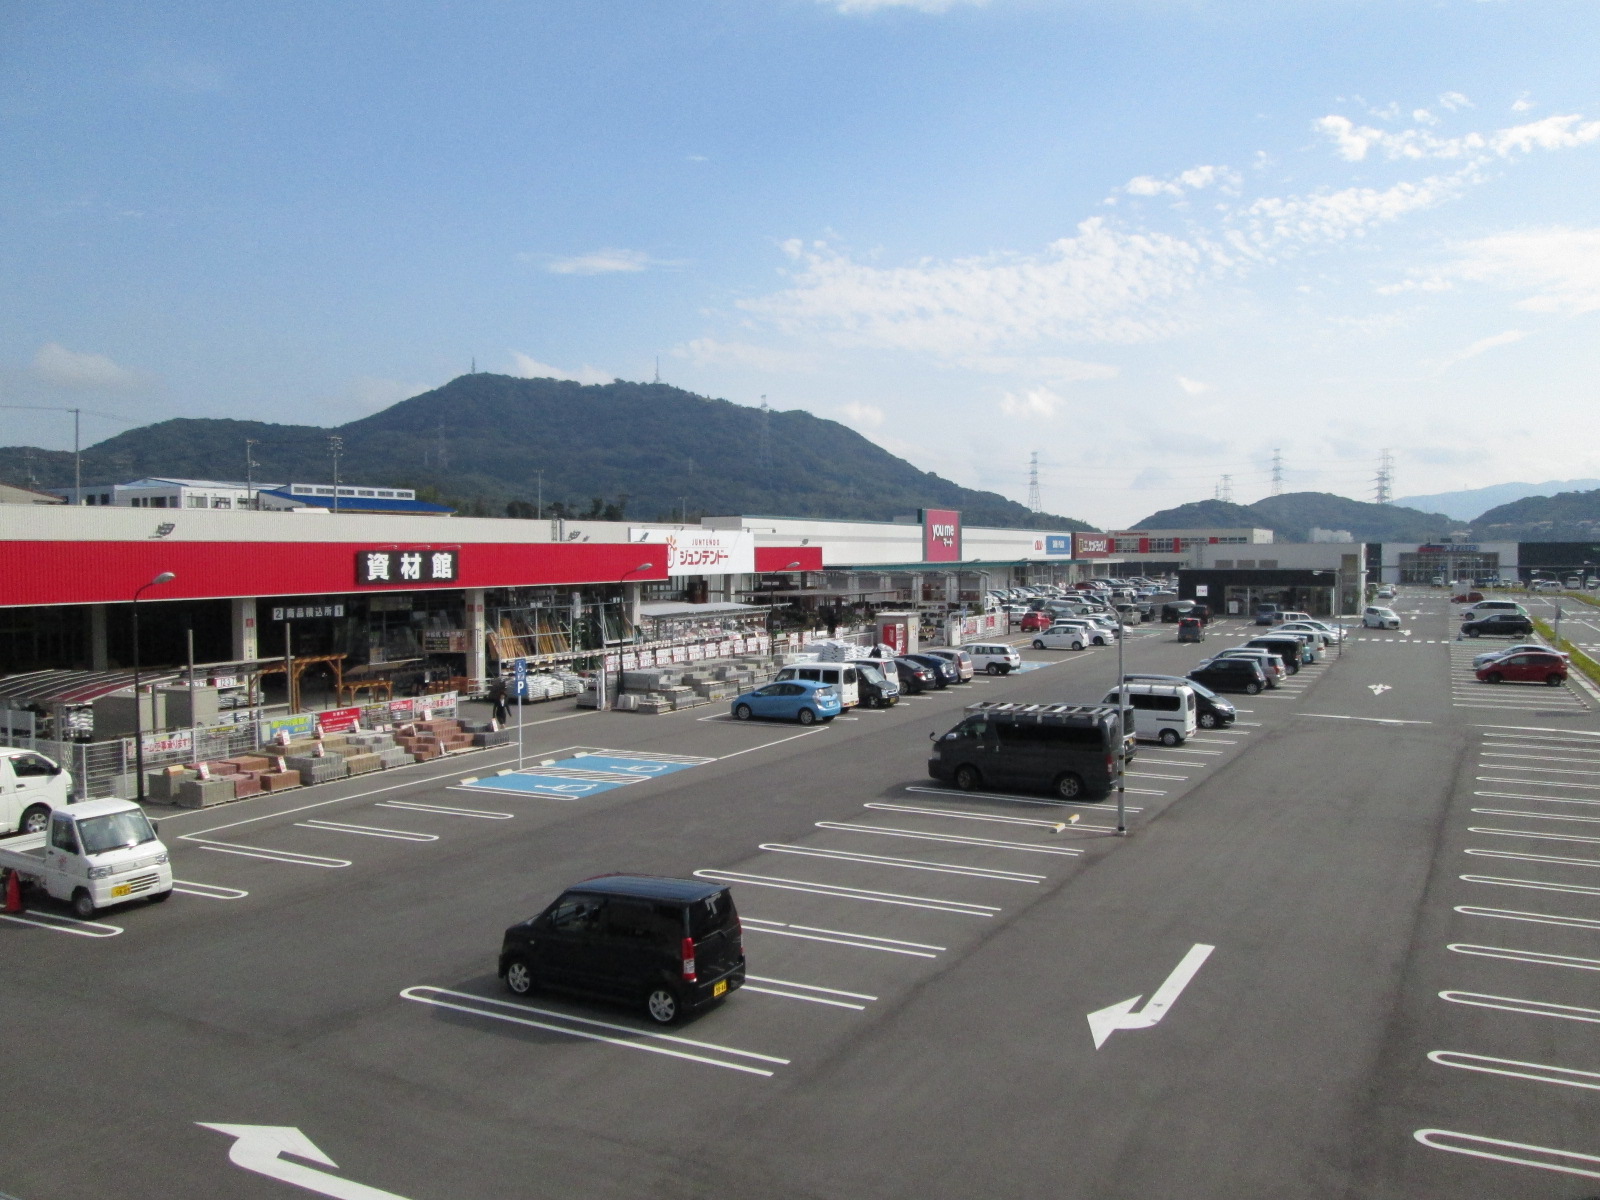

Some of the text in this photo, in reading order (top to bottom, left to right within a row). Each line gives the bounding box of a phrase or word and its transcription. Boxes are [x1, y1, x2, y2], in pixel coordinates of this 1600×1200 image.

[692, 538, 720, 546] JUNTENDO
[680, 549, 729, 565] ジュンテンドー
[367, 553, 452, 581] 資材館
[517, 681, 524, 693] P
